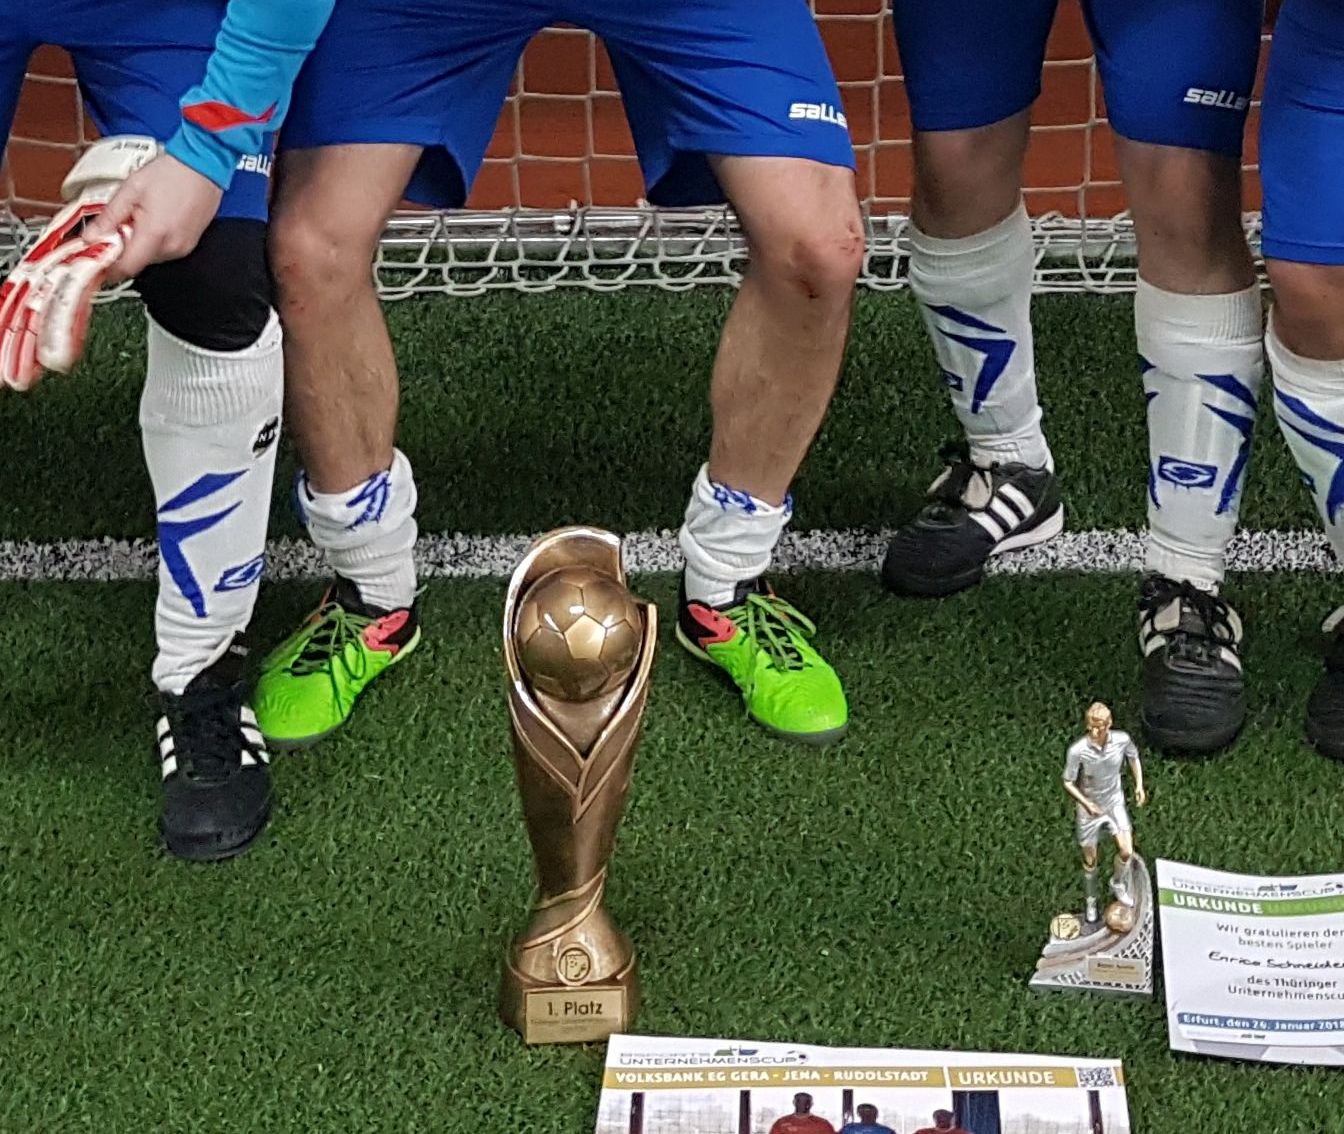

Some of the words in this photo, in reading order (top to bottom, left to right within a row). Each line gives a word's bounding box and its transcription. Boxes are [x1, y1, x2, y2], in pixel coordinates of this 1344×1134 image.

[788, 102, 849, 128] salle
[1172, 894, 1264, 914] URKUNDE
[1216, 923, 1239, 933] Wir
[1244, 926, 1320, 938] gratulieren
[1238, 936, 1284, 949] besten
[1286, 940, 1333, 950] Spieler
[1247, 975, 1271, 986] des
[1274, 977, 1338, 989] Thüringer
[548, 1001, 559, 1016] 1.
[564, 1000, 603, 1015] Platz
[1226, 1018, 1250, 1029] den
[1274, 1021, 1315, 1030] Januar
[619, 1056, 798, 1066] UNTERNEHMENSCUP
[615, 1070, 704, 1083] VOLKSBANK
[707, 1071, 726, 1082] EG
[730, 1070, 770, 1082] GERA
[782, 1070, 821, 1081] JENA
[833, 1070, 929, 1082] RUDOLSTADT
[958, 1069, 1056, 1085] URKUNDE
